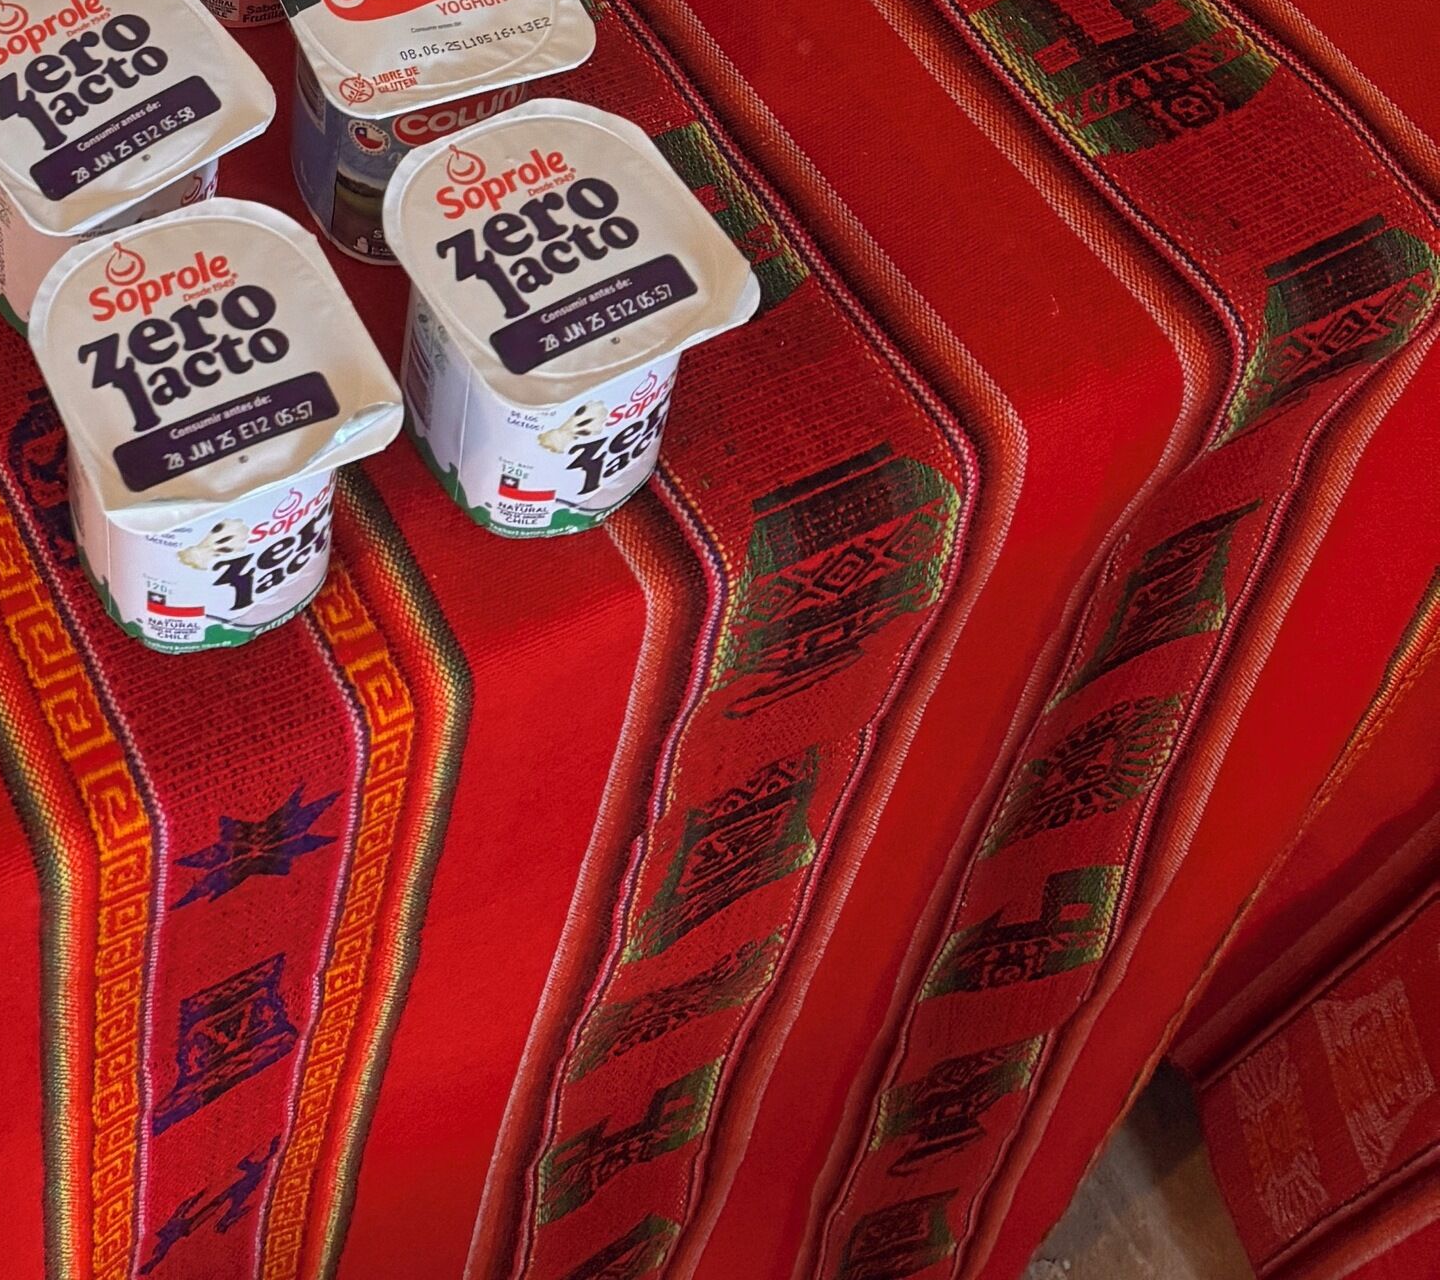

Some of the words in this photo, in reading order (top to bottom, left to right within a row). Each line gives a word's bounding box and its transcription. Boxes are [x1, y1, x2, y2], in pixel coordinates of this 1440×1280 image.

[17, 46, 168, 151] lacto
[371, 68, 403, 85] LIBRE
[404, 66, 421, 78] DE
[377, 78, 418, 95] GLUTEN
[71, 166, 90, 184] 28
[93, 151, 116, 172] JUN
[114, 140, 133, 158] 25
[132, 125, 162, 147] E12
[160, 106, 196, 131] 05:58
[77, 121, 120, 152] Consumir
[120, 109, 146, 127] antes
[146, 101, 162, 113] de:
[435, 148, 569, 220] Soprole
[528, 180, 554, 197] Desde
[436, 177, 619, 281] zero
[89, 251, 230, 322] Soprole
[475, 216, 639, 319] lacto
[540, 297, 588, 324] Consumir
[588, 284, 616, 302] antes
[616, 278, 633, 291] de:
[78, 285, 276, 389] zero
[539, 333, 560, 352] 28
[563, 321, 587, 343] JUN
[586, 312, 606, 332] 25
[606, 298, 638, 322] E12
[636, 283, 673, 309] 05:57
[111, 328, 290, 432] lacto
[605, 380, 668, 427] Sopr
[162, 452, 185, 470] 28
[188, 440, 215, 461] JUN
[216, 430, 237, 450] 25
[238, 416, 271, 439] E12
[274, 400, 313, 427] 05:57
[169, 413, 222, 439] Consumir
[223, 401, 253, 419] antes
[253, 394, 272, 407] de:
[566, 390, 670, 470] zer
[577, 412, 664, 495] lac
[248, 485, 329, 544] Sopro
[497, 502, 549, 513] NATURAL
[505, 517, 538, 525] CHILE
[212, 502, 333, 586] zer
[148, 618, 200, 629] NATURAL
[157, 632, 191, 640] CHILE
